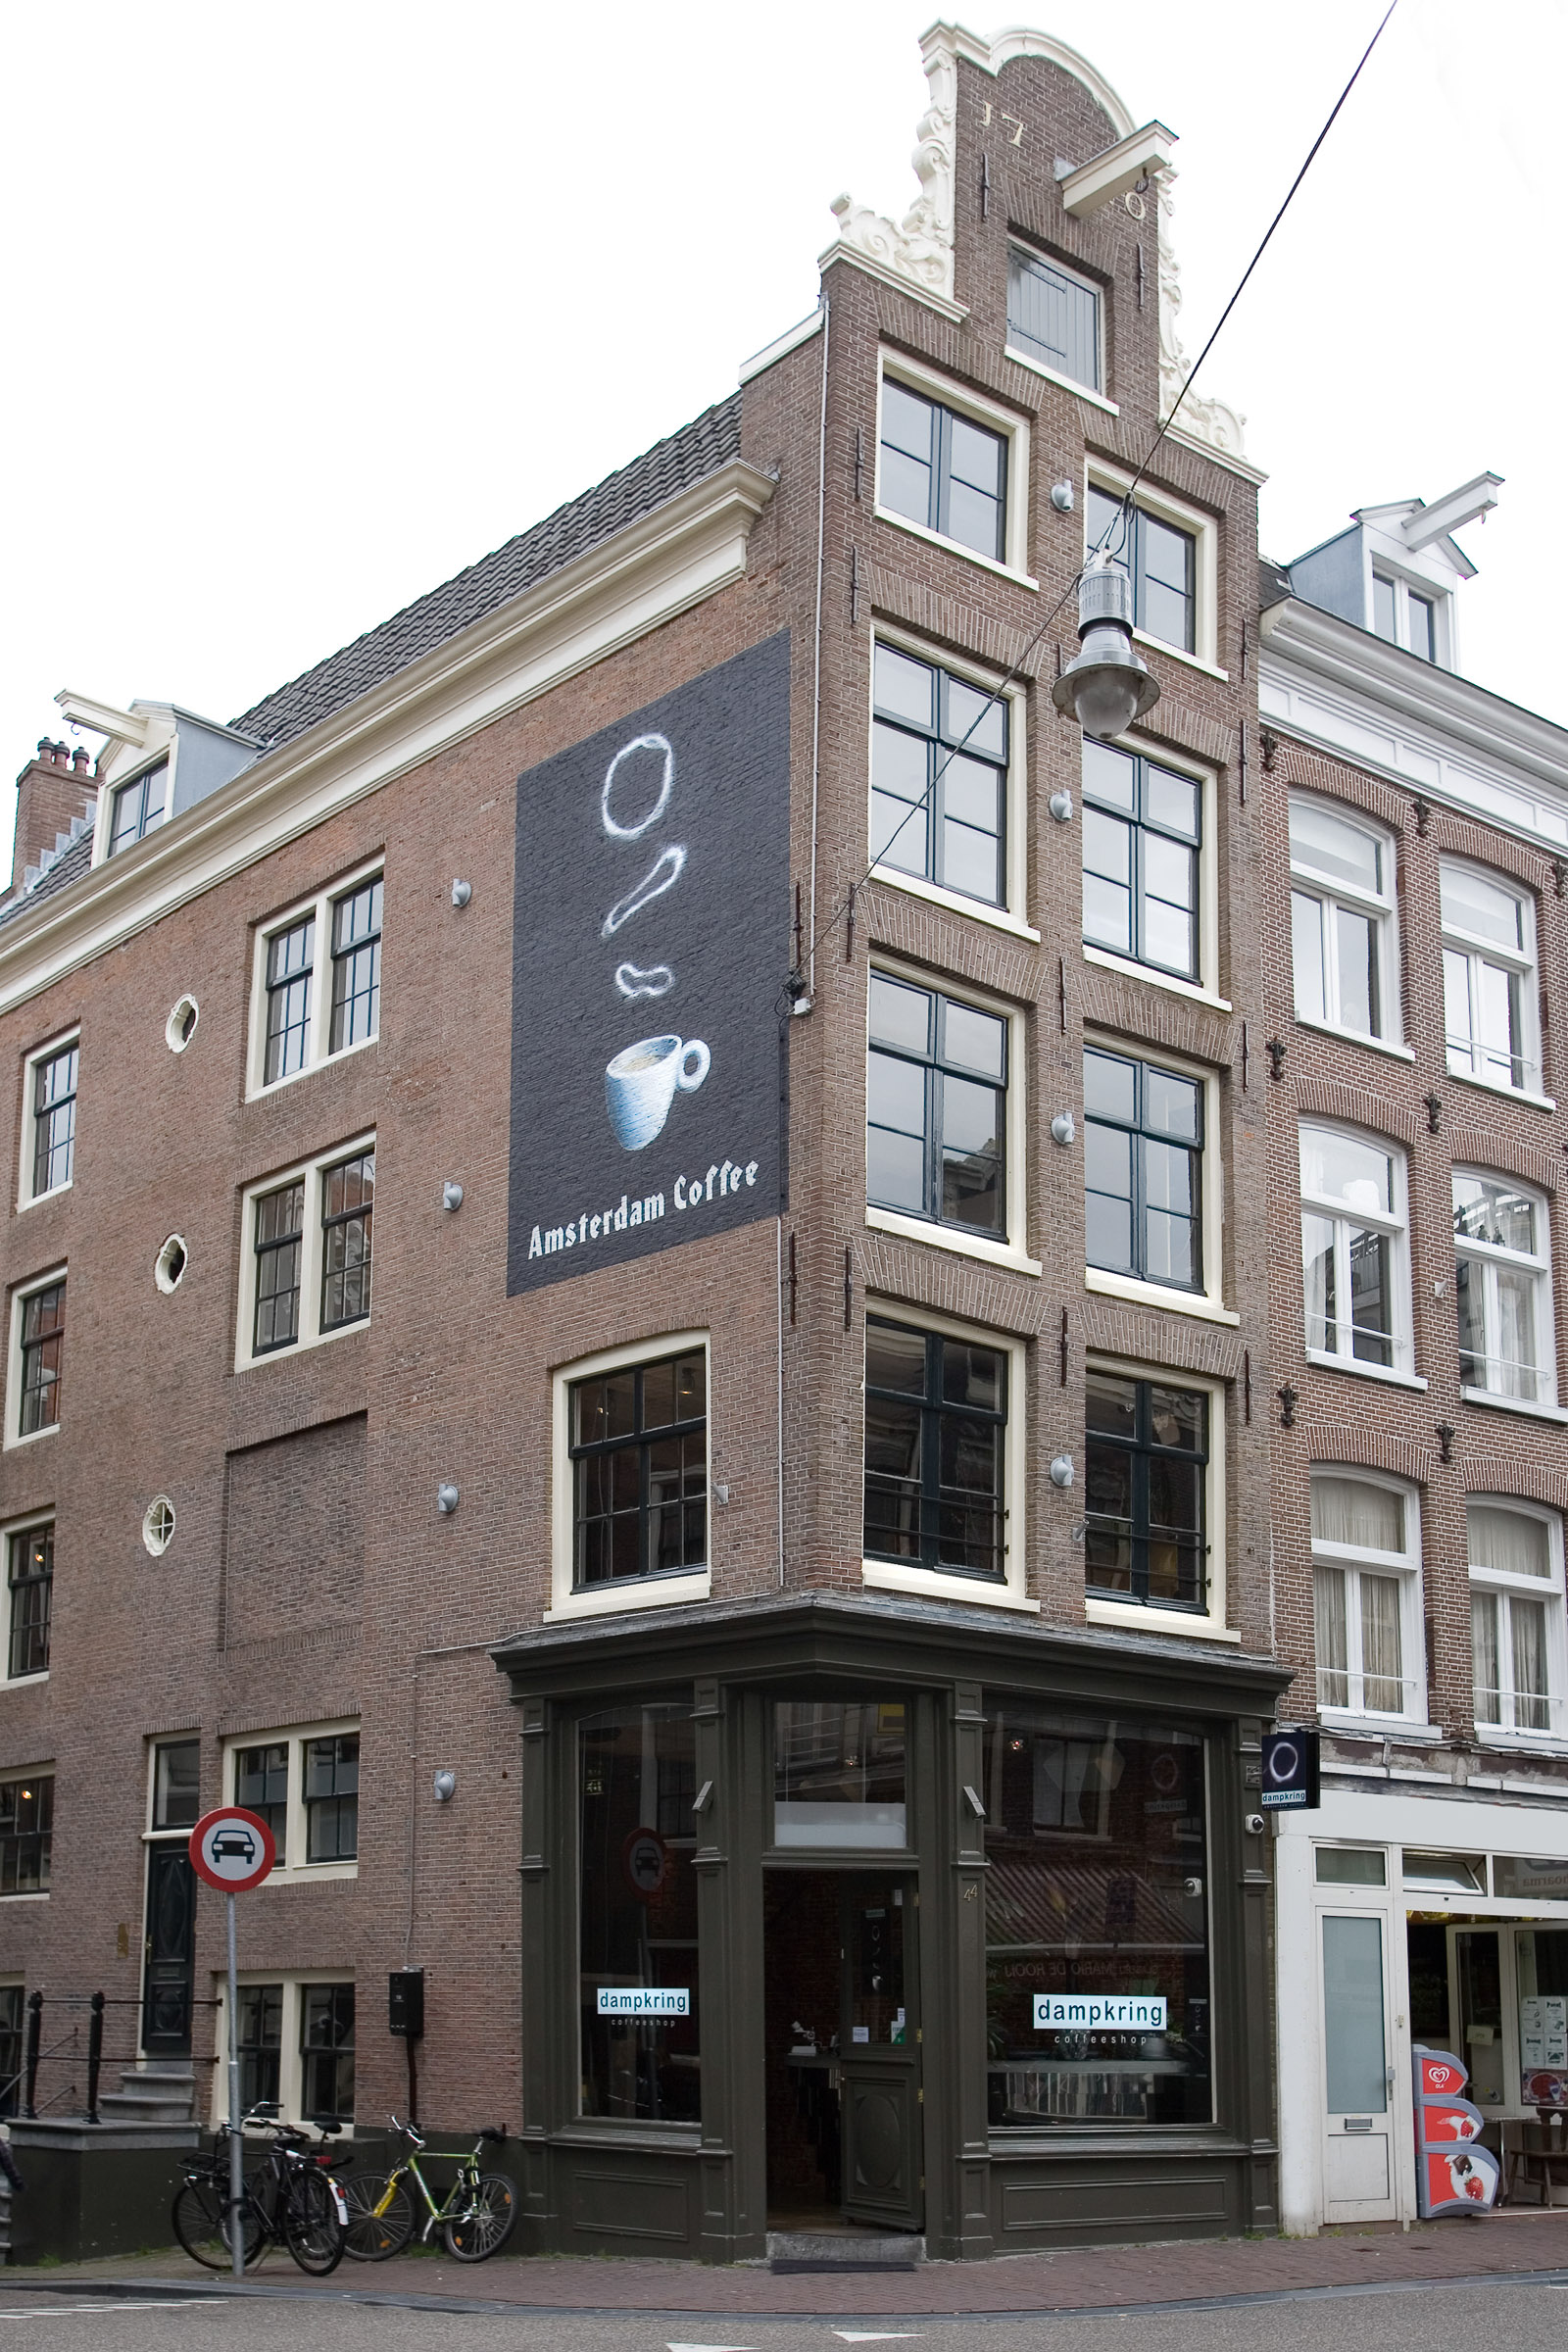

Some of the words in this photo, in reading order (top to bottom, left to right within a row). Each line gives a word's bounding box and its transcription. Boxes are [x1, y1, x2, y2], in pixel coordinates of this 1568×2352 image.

[528, 1193, 664, 1259] Amsterdam
[673, 1159, 760, 1209] Coffee
[1262, 1792, 1305, 1802] dampkring
[963, 1885, 977, 1901] 44
[600, 1991, 686, 2012] dampkring
[1038, 1999, 1162, 2026] dampkring
[611, 2019, 675, 2028] coffeeshop
[1054, 2034, 1147, 2045] coffeeshop
